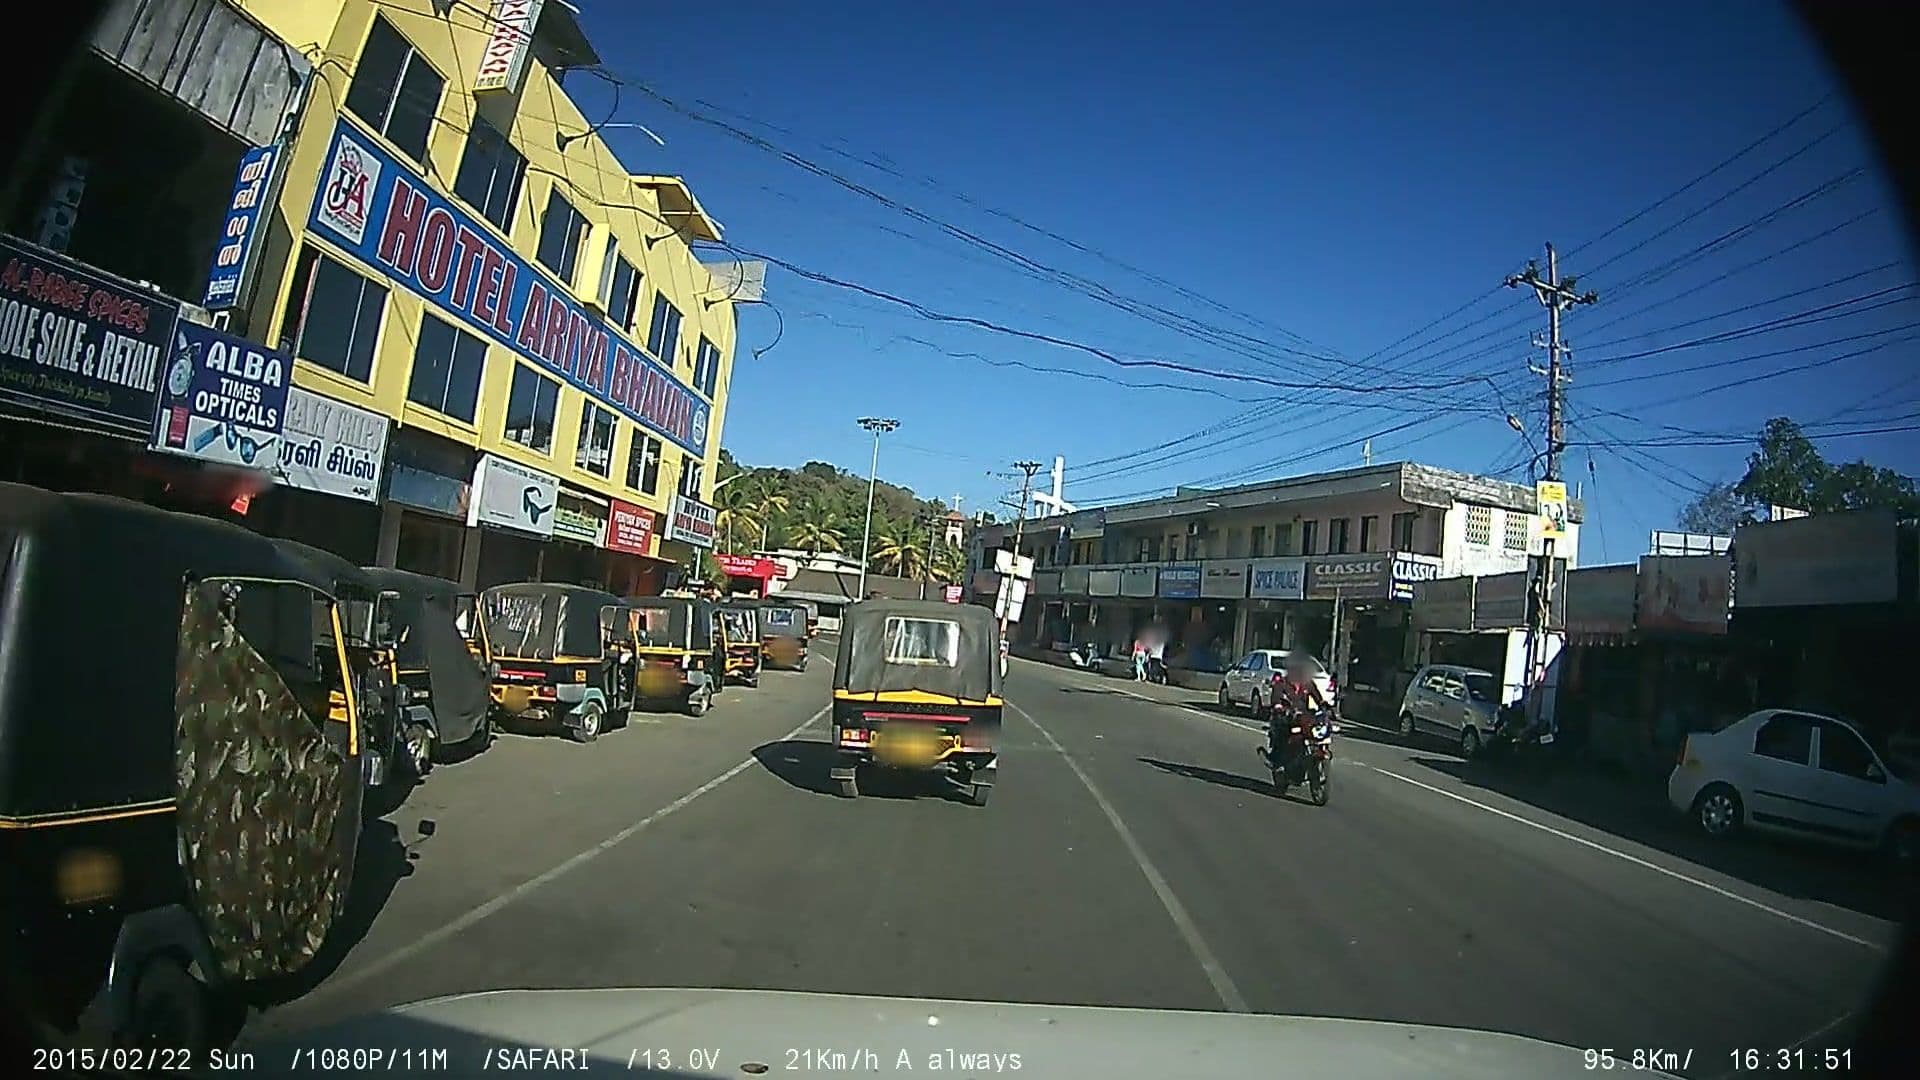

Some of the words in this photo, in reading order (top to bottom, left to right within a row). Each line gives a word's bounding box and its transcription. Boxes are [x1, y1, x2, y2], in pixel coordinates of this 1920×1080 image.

[87, 289, 149, 334] SPICES
[376, 175, 518, 339] HOTEL
[516, 280, 609, 395] ARIYA
[609, 343, 695, 446] BHAVAN
[36, 311, 87, 373] SALE
[82, 343, 95, 377] &
[97, 331, 160, 393] RETAIL
[206, 341, 283, 388] ALBA
[195, 391, 278, 429] OPTICALS
[220, 378, 262, 404] TIMES
[335, 409, 385, 455] CHIPS
[278, 439, 322, 467] ரளி
[326, 446, 376, 482] சிப்ஸ்
[1254, 569, 1274, 589] SPICE
[1314, 561, 1383, 575] CLASSIC
[1393, 560, 1436, 581] CLASSIC
